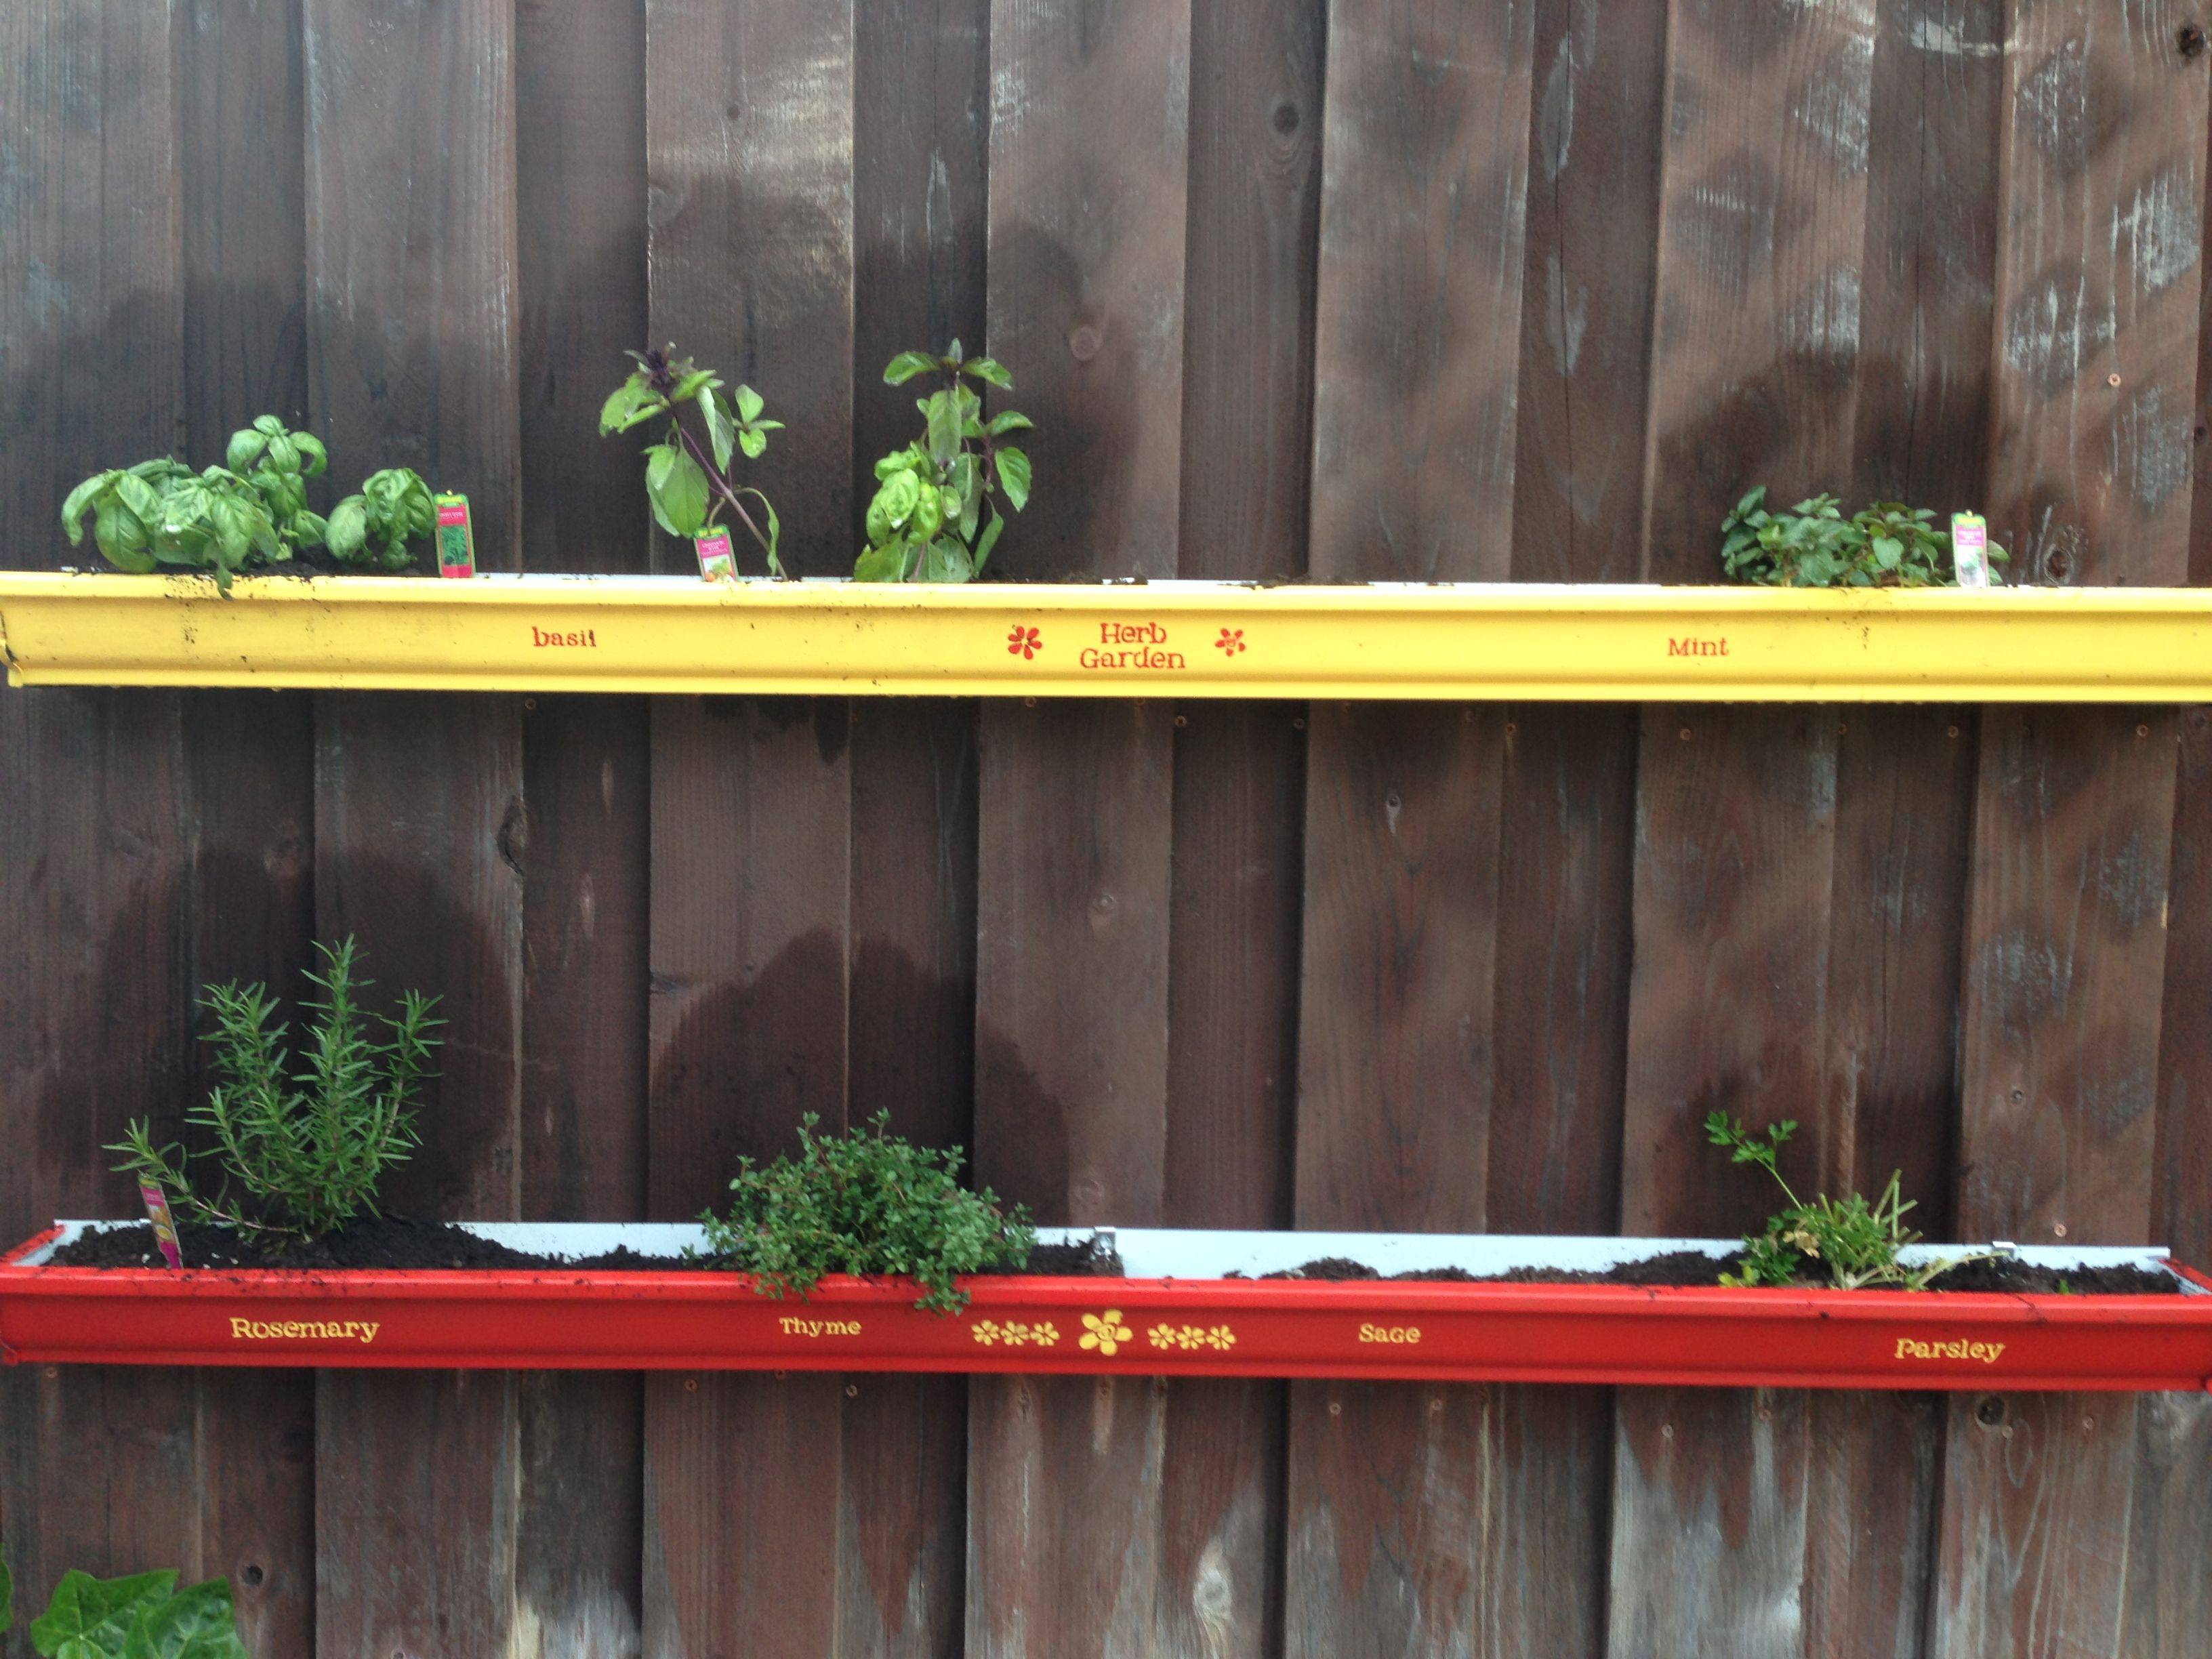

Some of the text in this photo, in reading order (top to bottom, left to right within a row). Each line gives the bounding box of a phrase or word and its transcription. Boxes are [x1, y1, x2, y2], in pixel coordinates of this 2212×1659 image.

[531, 626, 596, 647] basil
[1100, 621, 1167, 644] Herb
[1668, 637, 1729, 656] Mint
[1080, 647, 1186, 669] Garden
[229, 1317, 380, 1343] Rosemary
[779, 1317, 862, 1338] Thyme
[1894, 1338, 2006, 1364] Parsley
